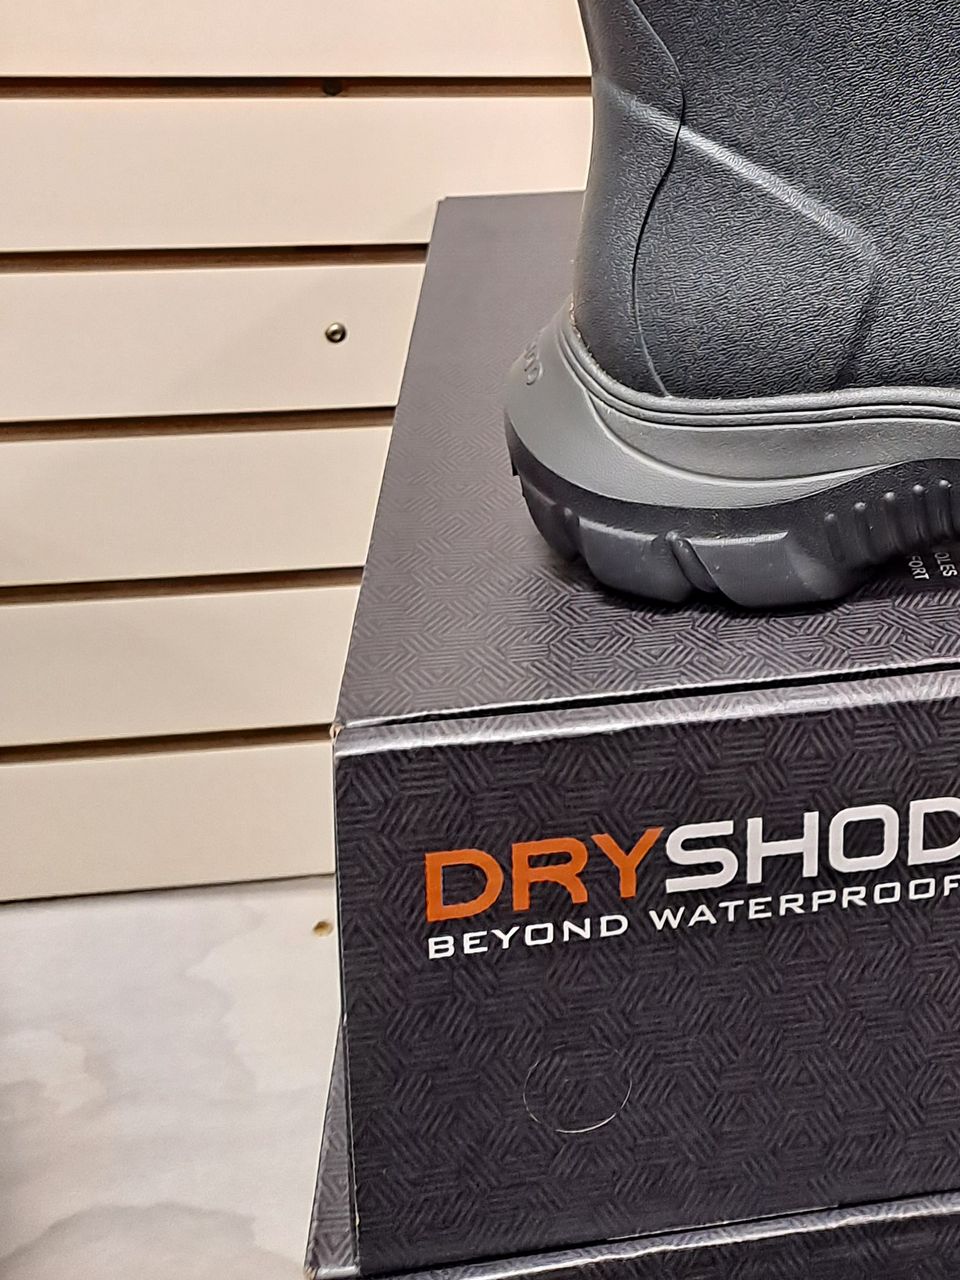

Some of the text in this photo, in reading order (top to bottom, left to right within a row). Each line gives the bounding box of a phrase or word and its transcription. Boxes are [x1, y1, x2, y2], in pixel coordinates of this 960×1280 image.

[908, 555, 930, 580] FORT
[934, 552, 958, 577] OLES
[428, 915, 628, 959] BEYOND
